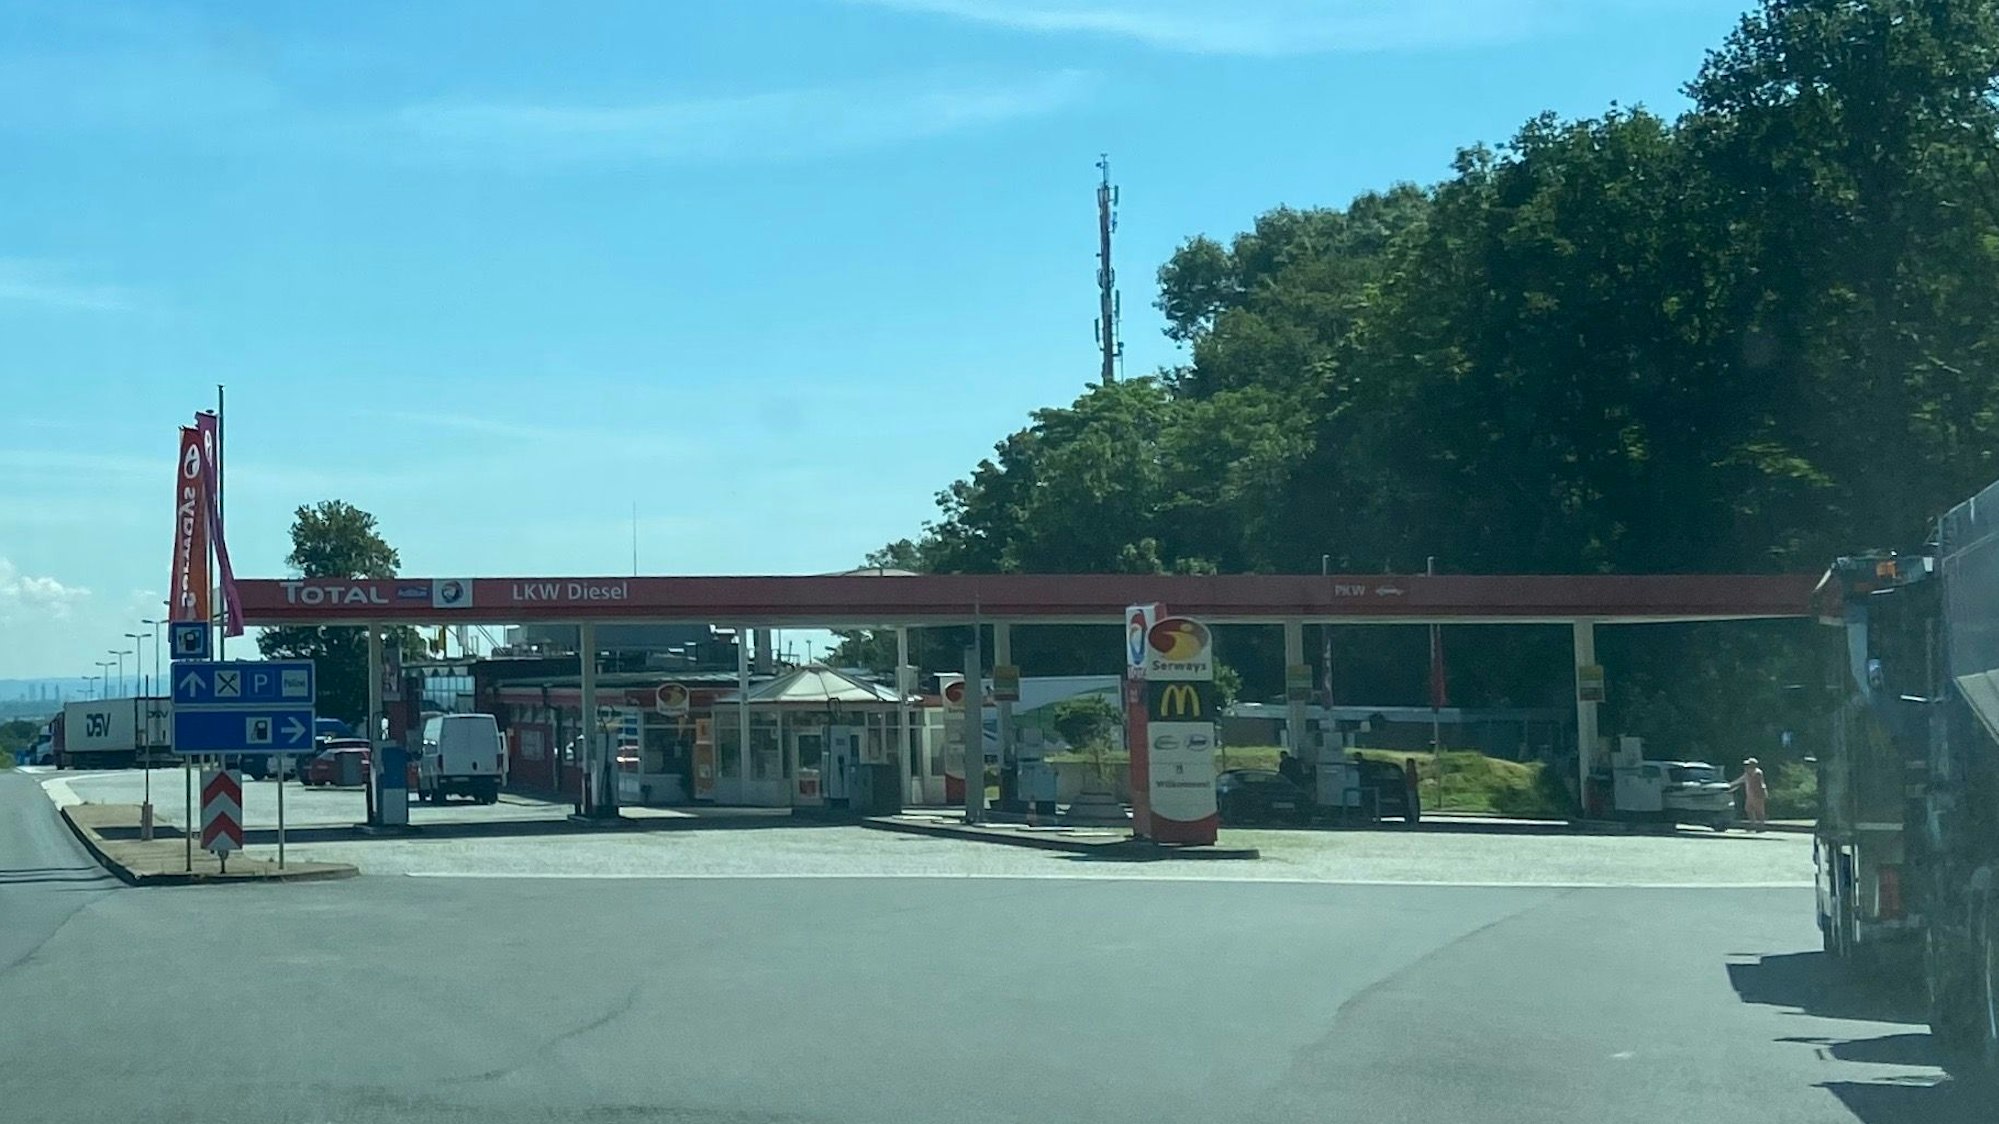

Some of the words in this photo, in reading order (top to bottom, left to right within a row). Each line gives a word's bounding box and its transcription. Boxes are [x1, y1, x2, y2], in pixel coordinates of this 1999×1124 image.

[279, 581, 389, 604] TOTAL
[513, 583, 560, 600] LKW
[567, 581, 628, 601] Diesel
[1334, 585, 1366, 597] PKW
[1152, 660, 1207, 674] Serways
[254, 673, 268, 693] P
[86, 712, 111, 737] DSV
